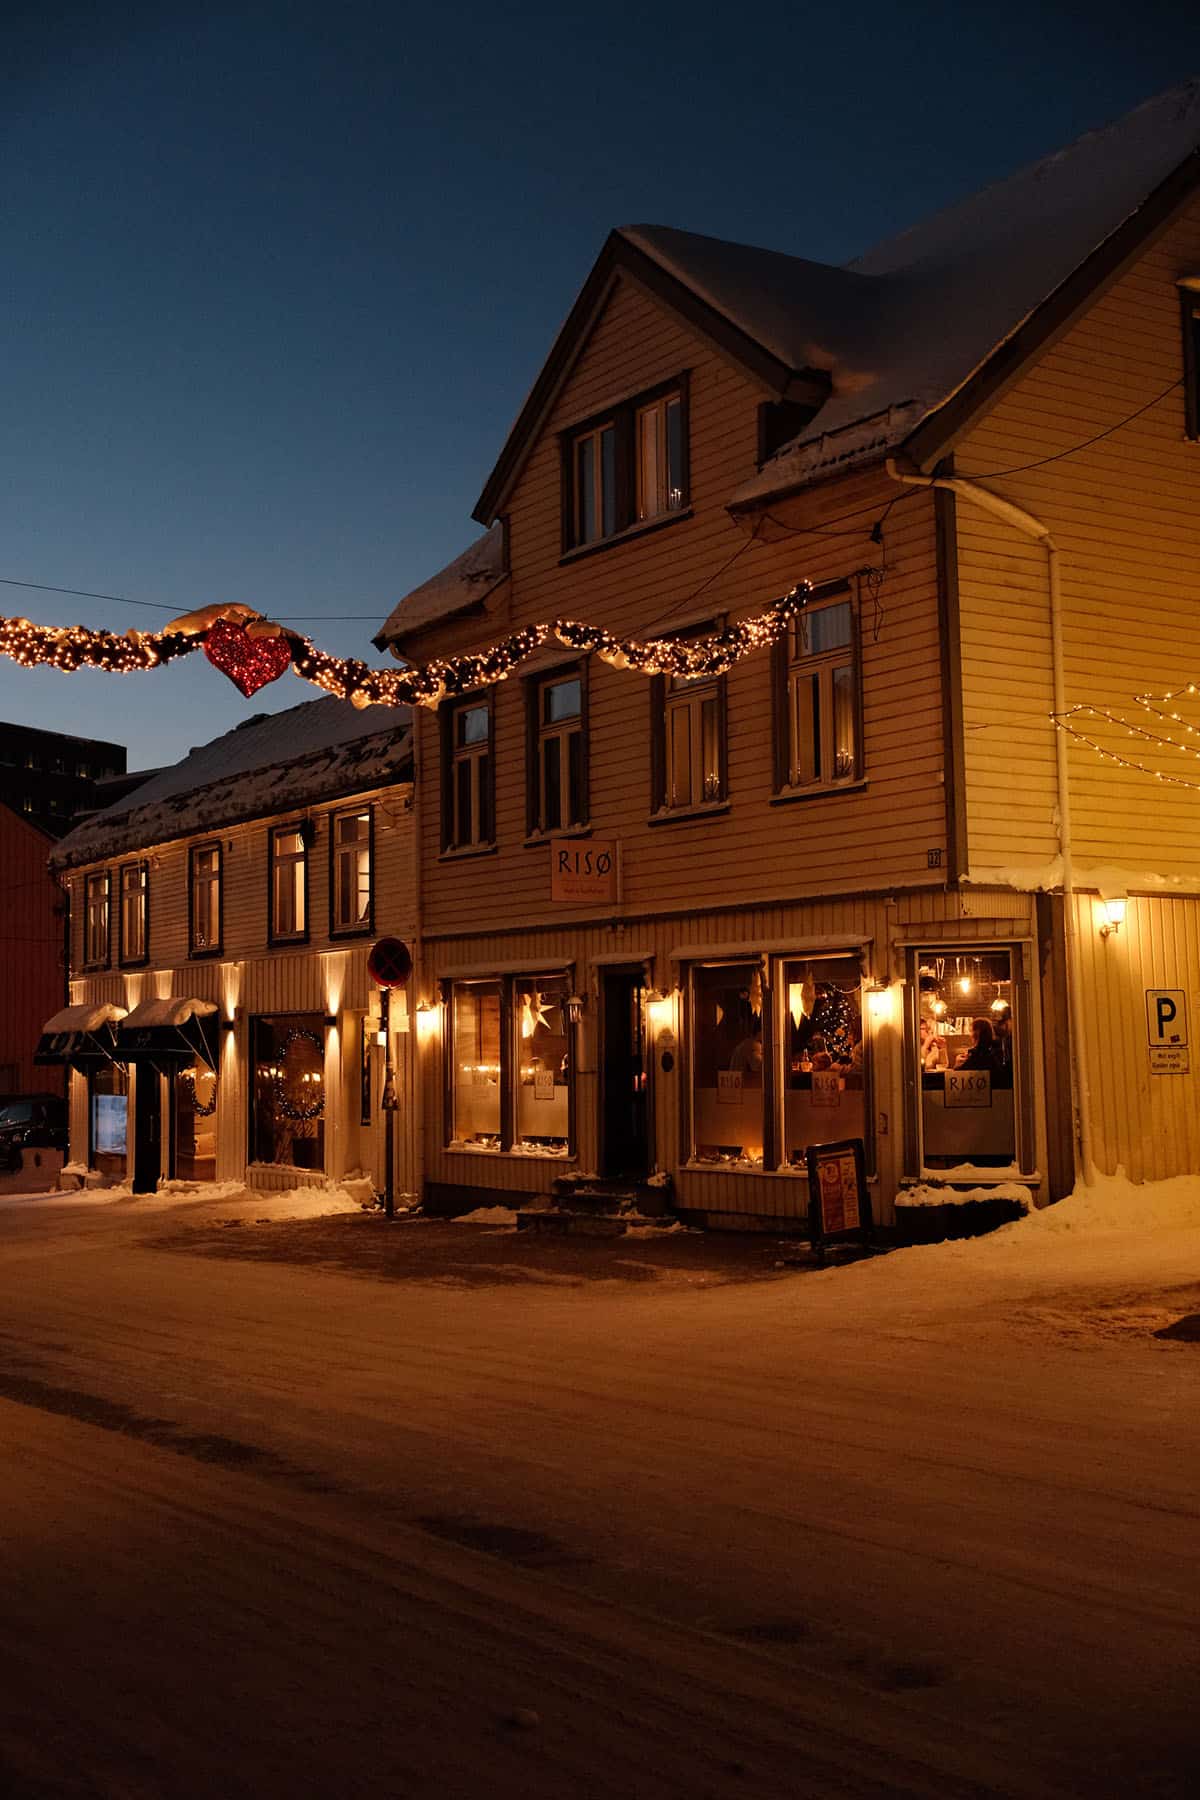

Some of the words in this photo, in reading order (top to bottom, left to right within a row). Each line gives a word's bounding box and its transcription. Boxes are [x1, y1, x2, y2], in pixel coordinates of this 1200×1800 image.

[558, 849, 612, 877] RISØ
[1157, 998, 1177, 1038] P
[950, 1076, 987, 1091] RISØ
